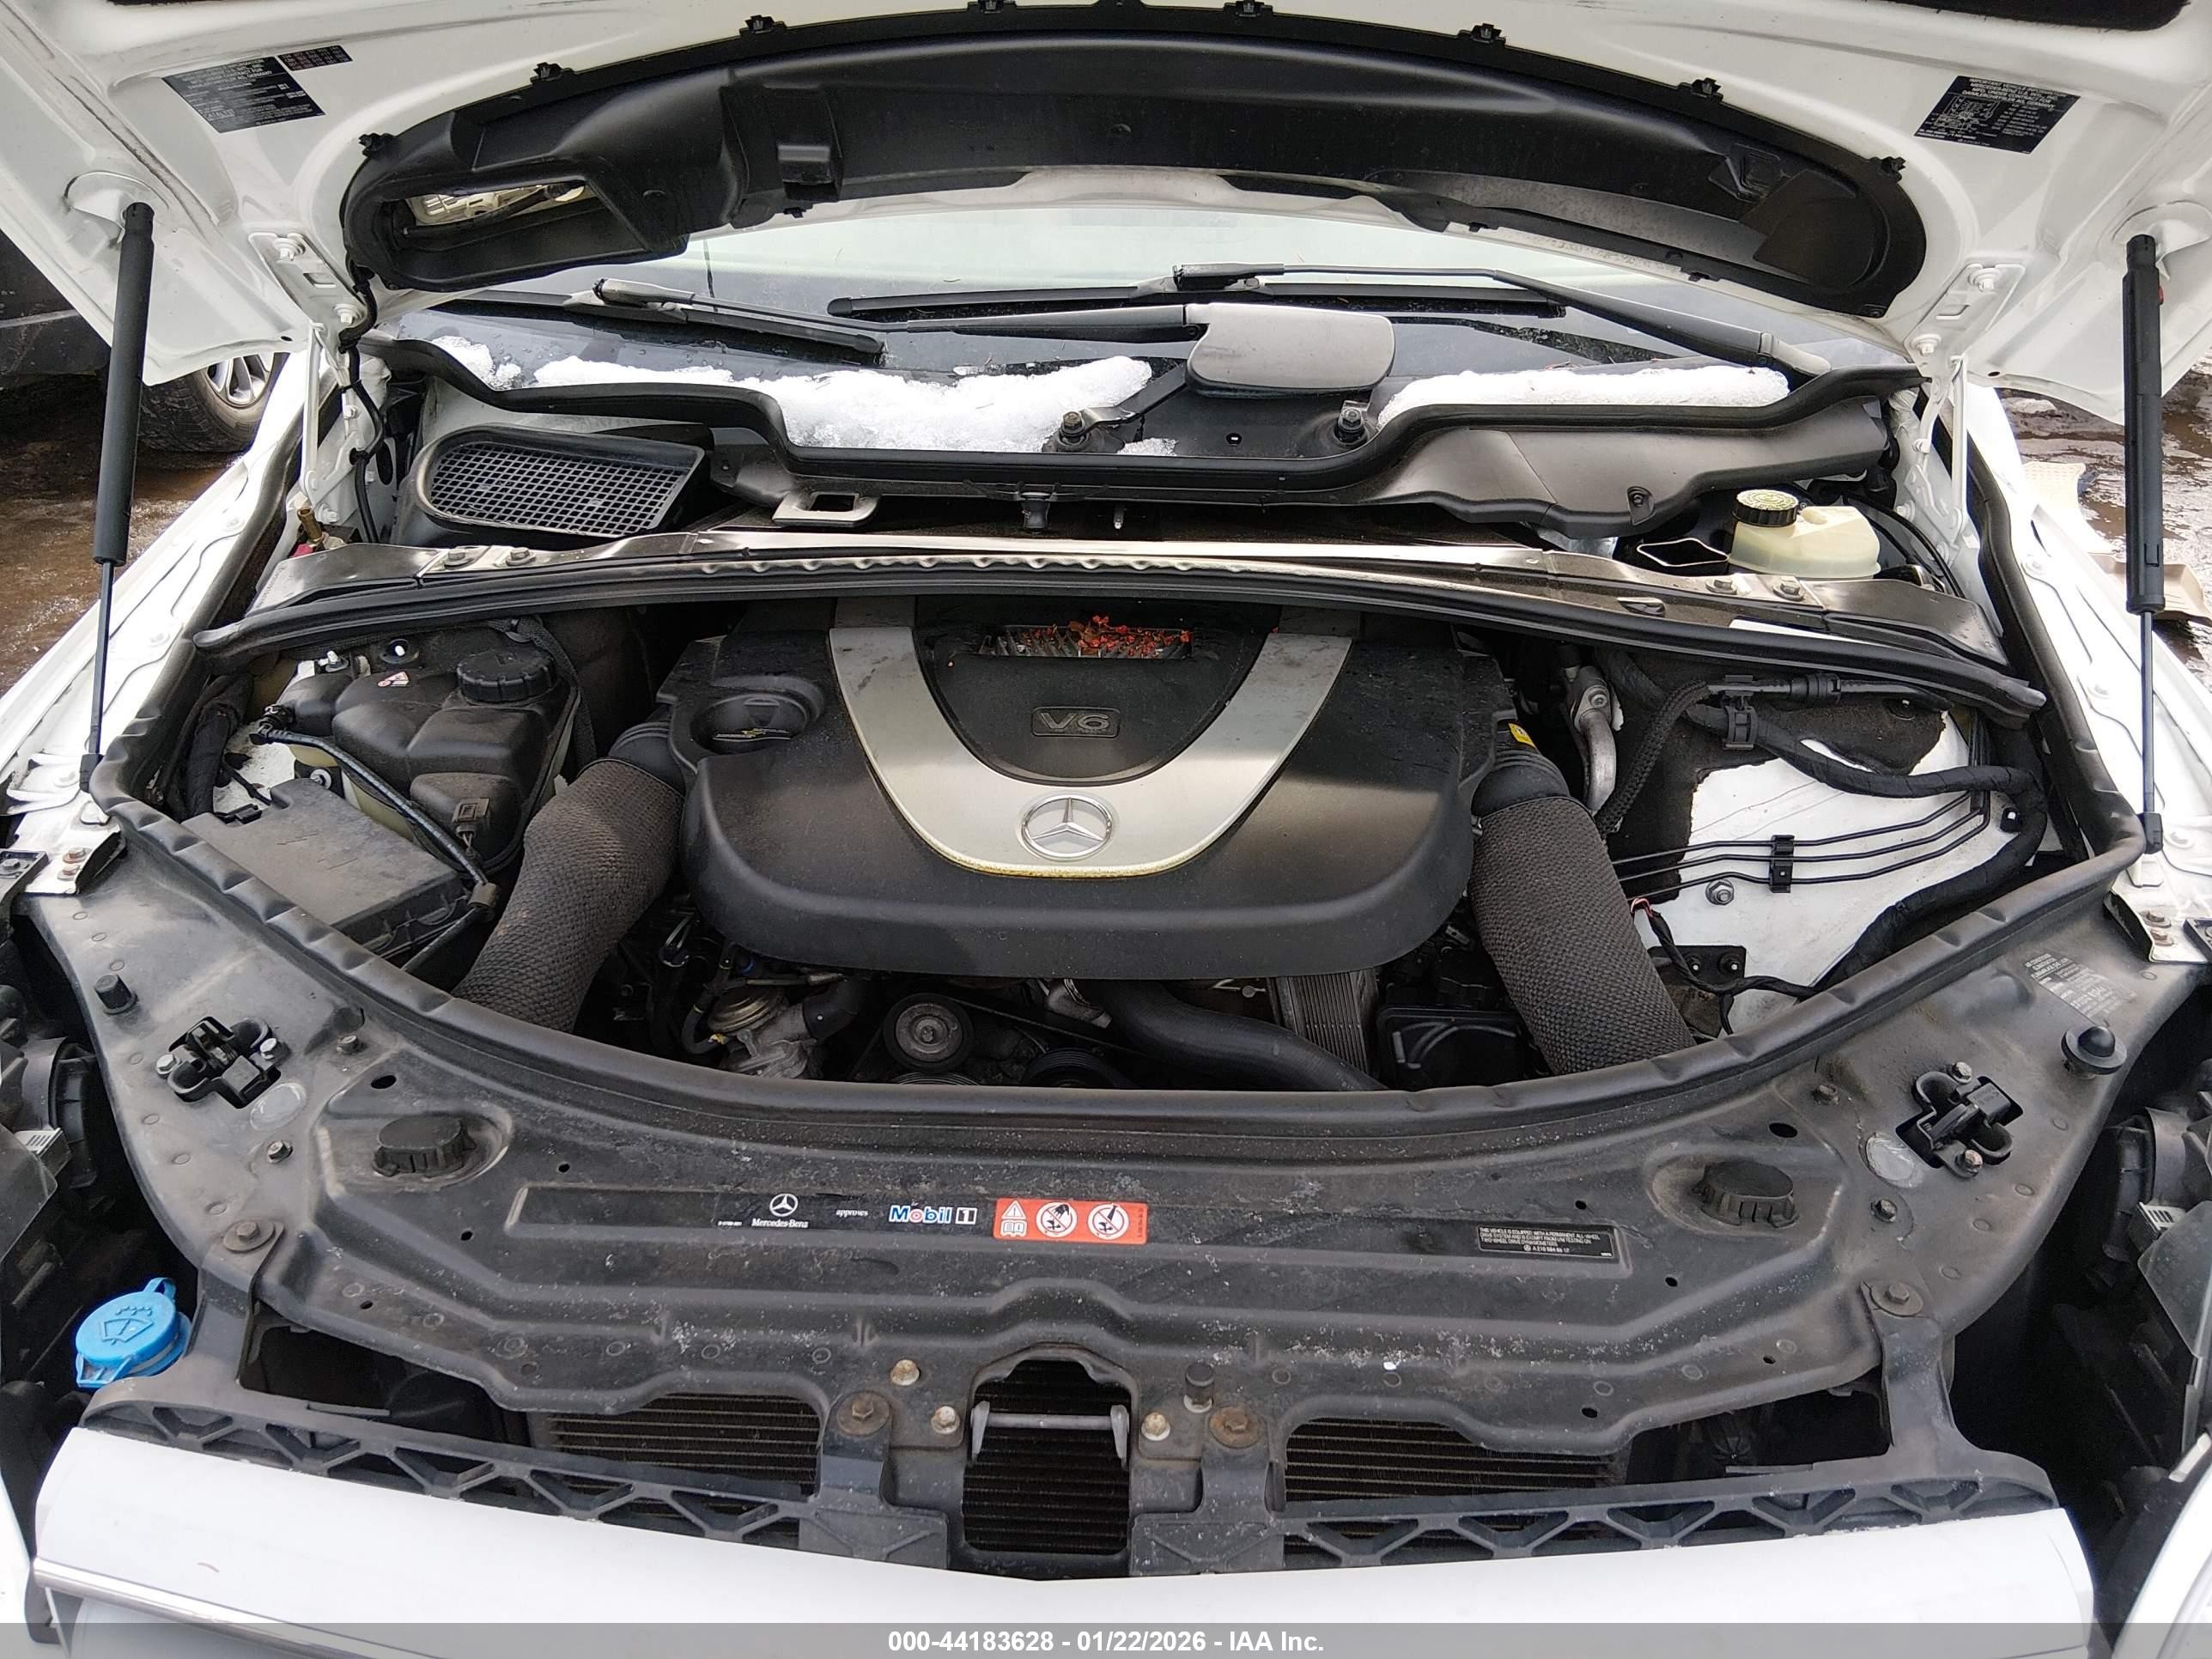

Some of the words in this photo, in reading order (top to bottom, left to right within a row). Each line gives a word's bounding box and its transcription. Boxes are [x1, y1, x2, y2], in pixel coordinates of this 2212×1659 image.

[1038, 712, 1109, 731] V6
[889, 1204, 952, 1223] Mobil
[751, 1218, 809, 1229] Mercedes-Benz
